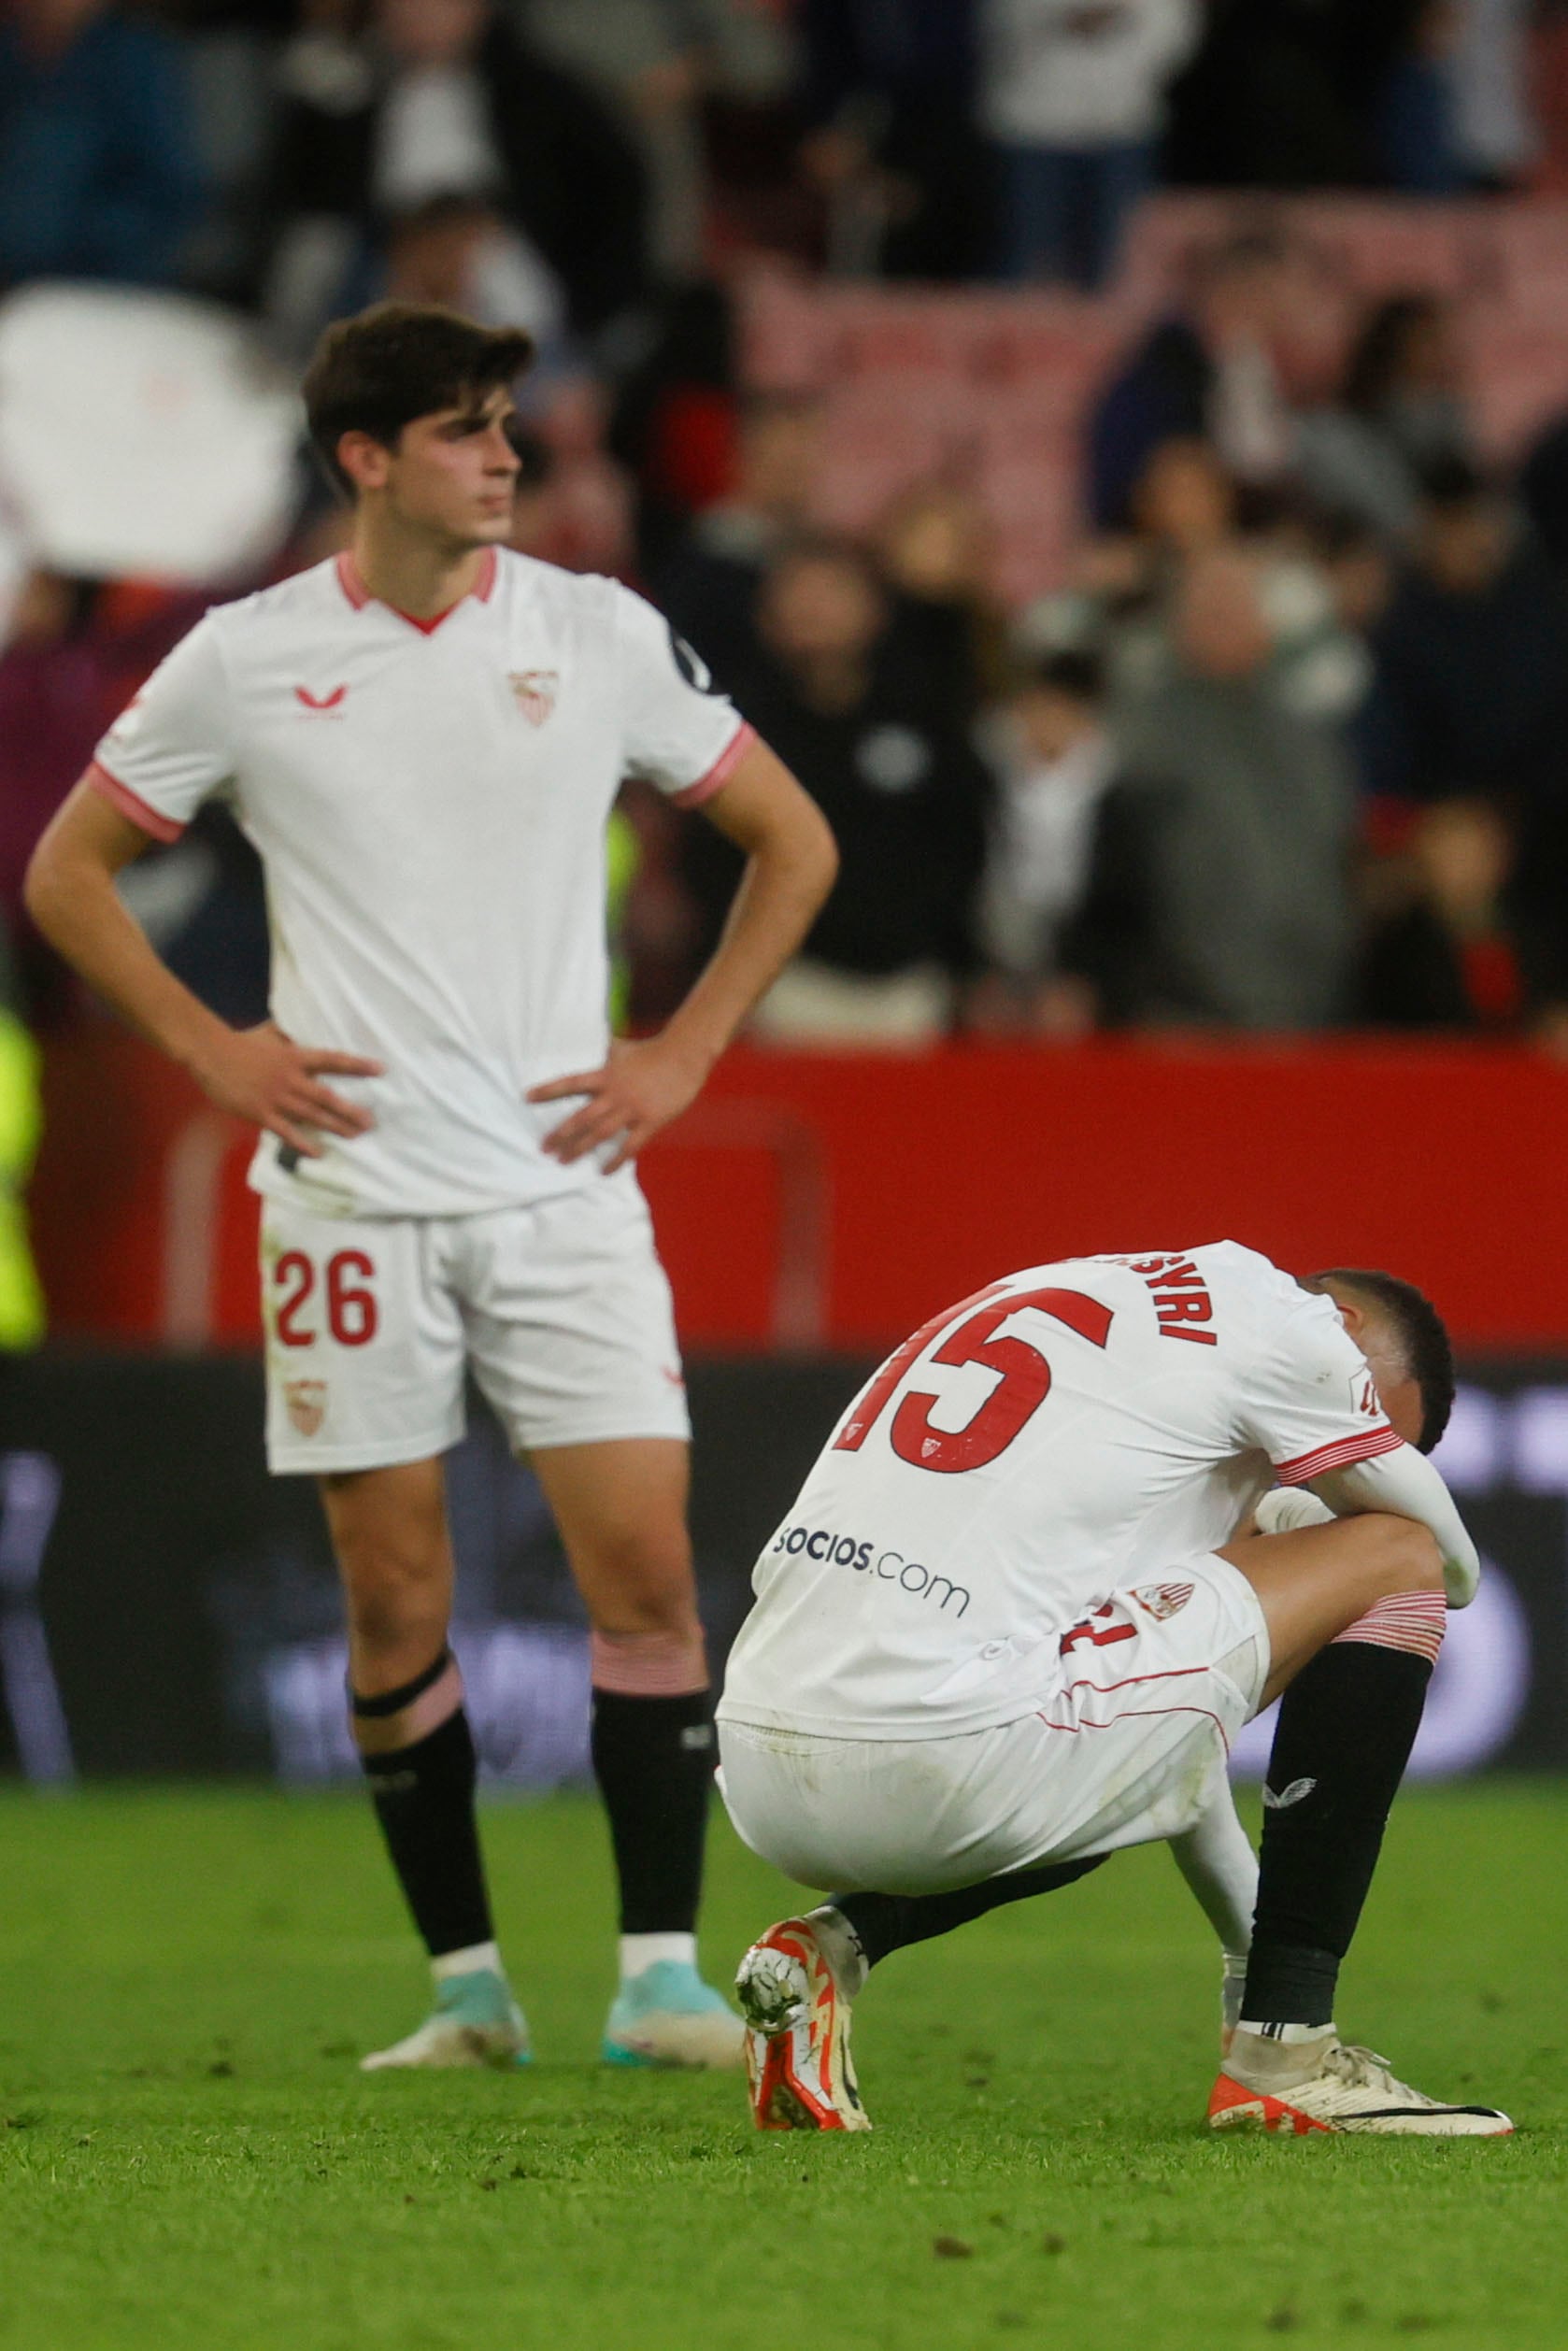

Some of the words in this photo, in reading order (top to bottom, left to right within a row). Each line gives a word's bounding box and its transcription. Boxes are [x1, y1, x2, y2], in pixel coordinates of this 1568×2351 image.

[275, 1249, 378, 1347] 26
[1116, 1254, 1219, 1346] SYRI
[831, 1284, 1115, 1475] 15
